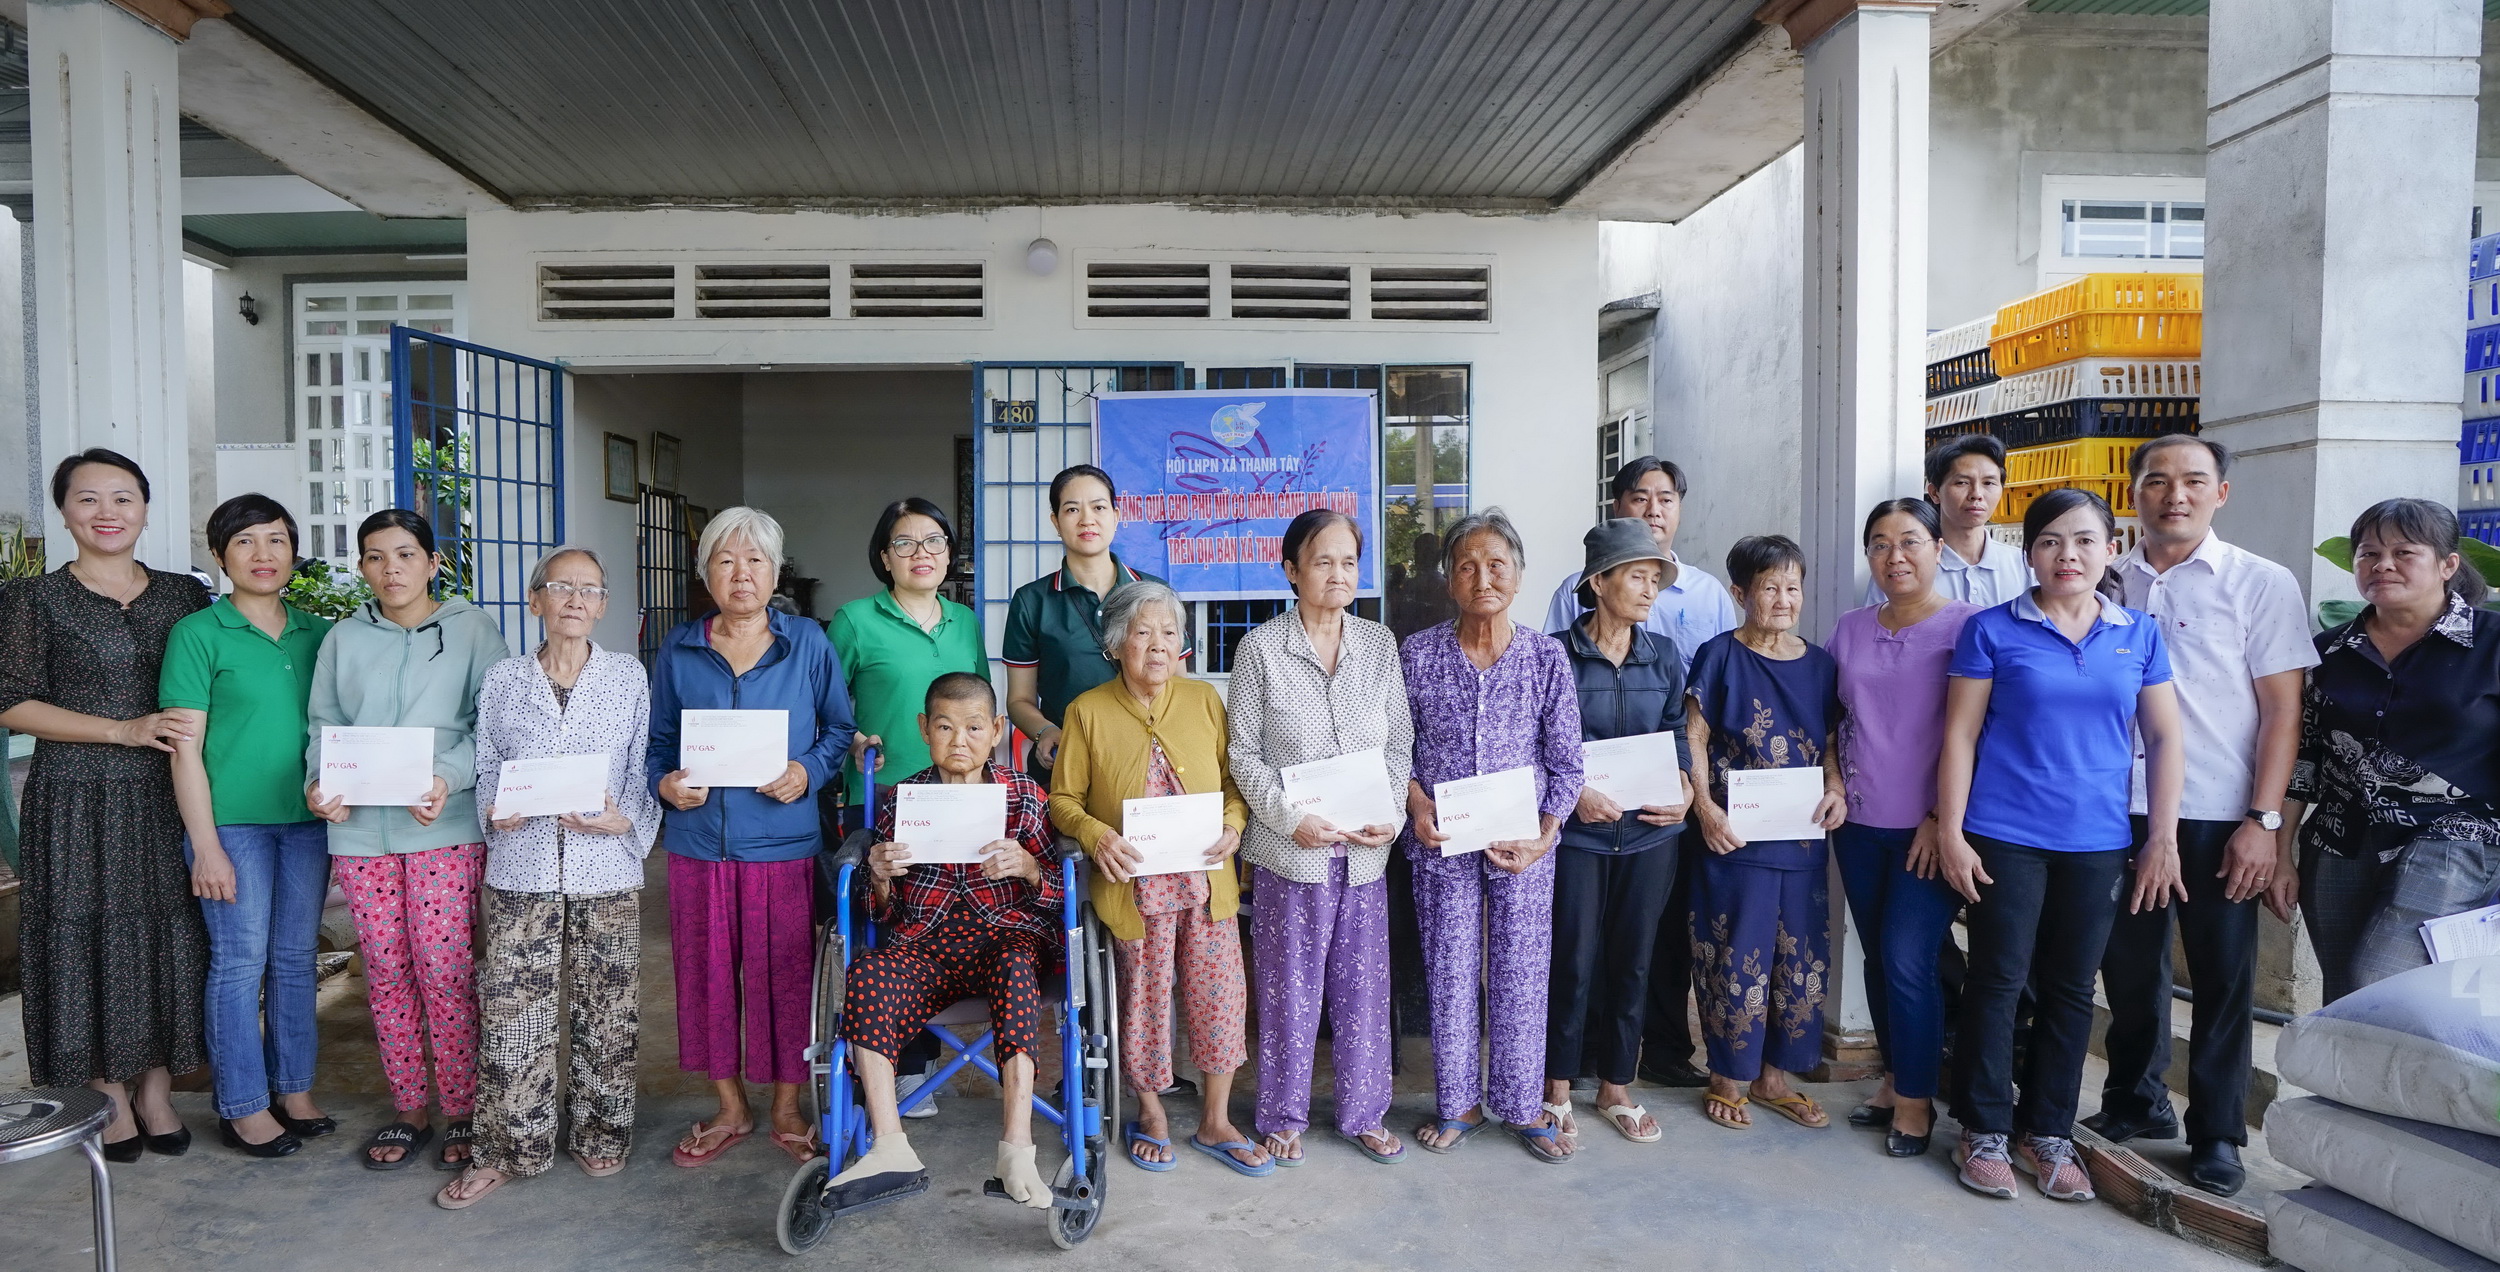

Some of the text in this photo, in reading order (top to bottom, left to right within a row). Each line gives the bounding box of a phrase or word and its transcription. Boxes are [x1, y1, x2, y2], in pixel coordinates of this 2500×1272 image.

[998, 406, 1034, 424] 480
[1166, 455, 1300, 477] HỘI LHPN XÃ THẠNH TÂY
[1115, 484, 1358, 528] TẶNG QUÀ CHO PHỤ NỮ CÓ HOÀN CẢNH KHÓ KHĂN
[1167, 530, 1284, 569] TRÊN ĐỊA BÀN XÃ THẠN
[698, 744, 716, 752] GAS
[1593, 773, 1610, 781] GAS
[1305, 796, 1322, 805] GAS
[1744, 802, 1760, 810] GAS
[1442, 812, 1470, 823] PV GAS
[901, 819, 931, 827] PV GAS
[1140, 833, 1157, 841] GAS
[444, 1127, 473, 1141] Chlo
